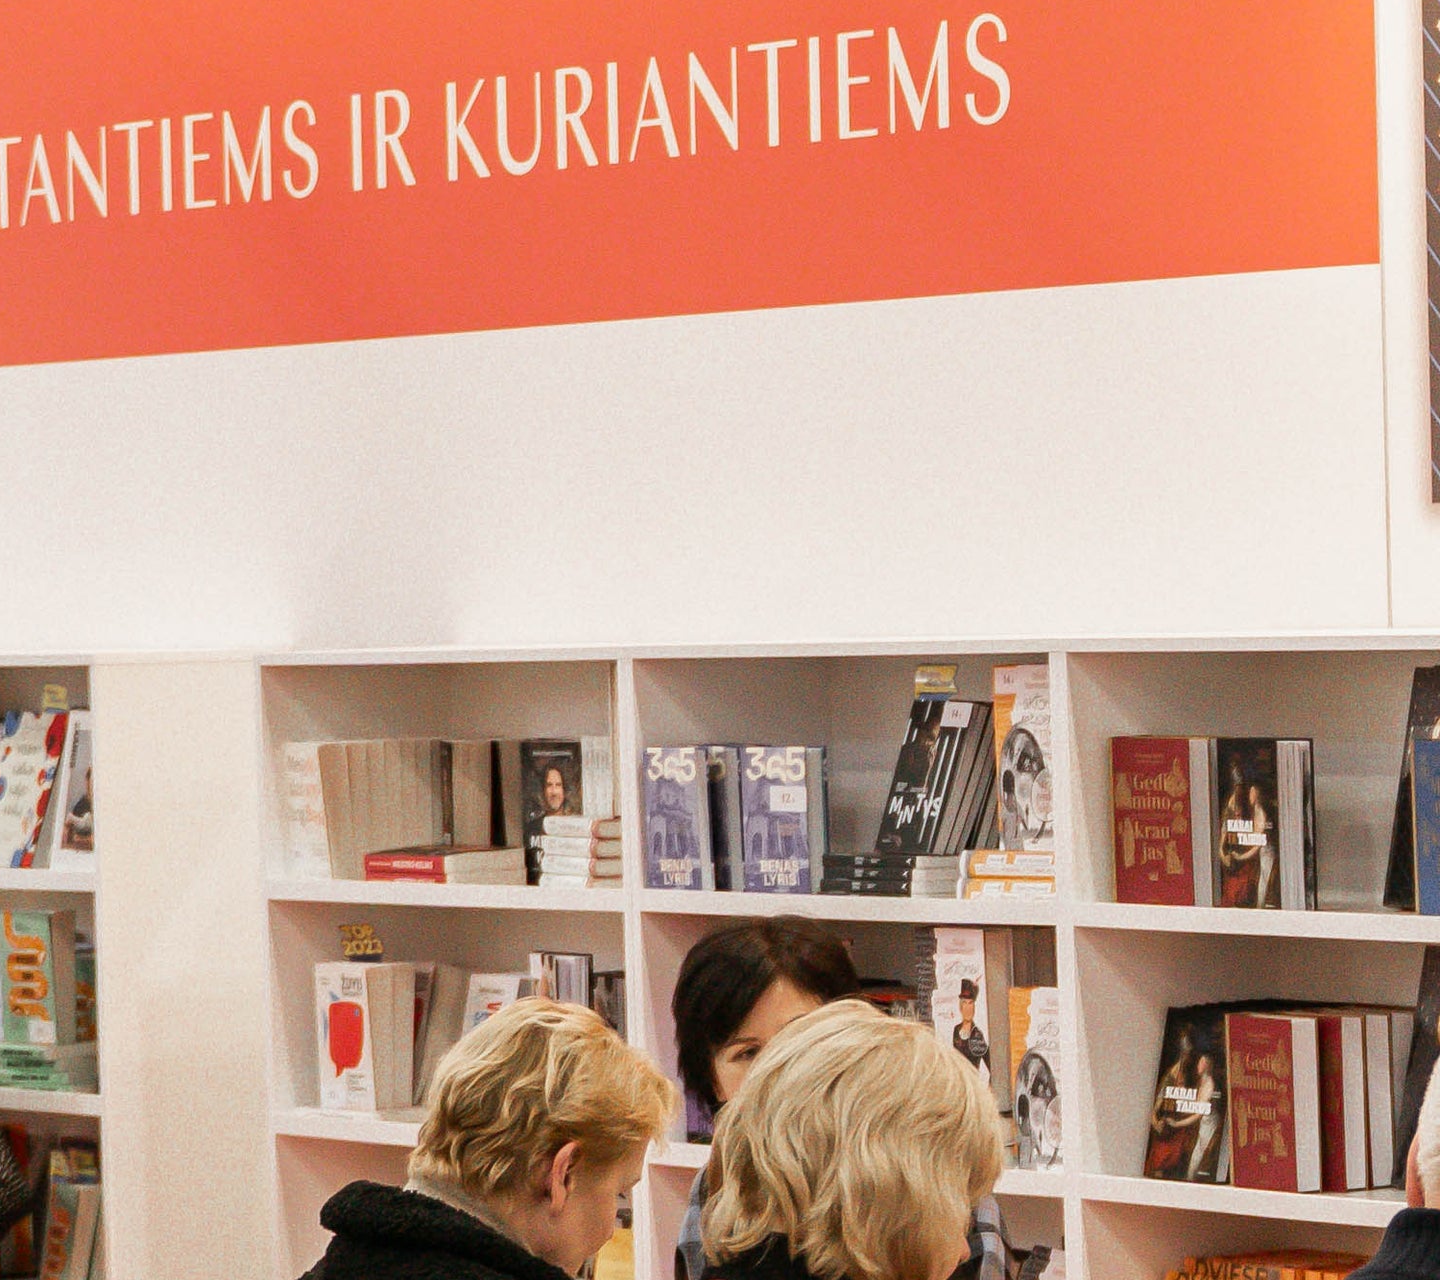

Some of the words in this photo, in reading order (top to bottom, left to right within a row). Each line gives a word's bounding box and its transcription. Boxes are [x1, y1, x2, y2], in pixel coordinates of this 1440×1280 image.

[352, 87, 417, 193] IR
[444, 11, 1013, 184] KURIANTIEMS
[646, 746, 696, 783] 365
[745, 746, 806, 783] 365
